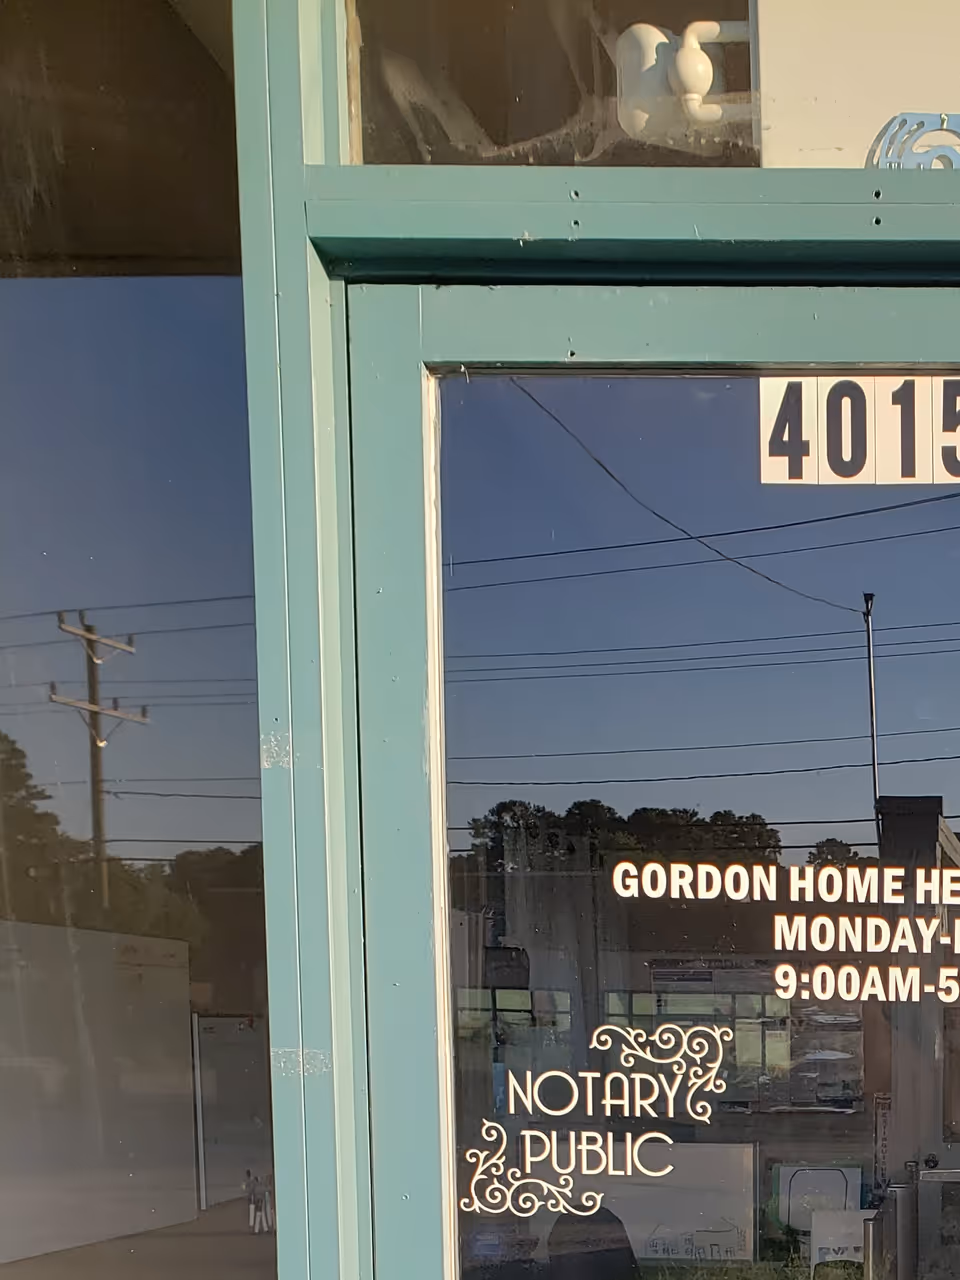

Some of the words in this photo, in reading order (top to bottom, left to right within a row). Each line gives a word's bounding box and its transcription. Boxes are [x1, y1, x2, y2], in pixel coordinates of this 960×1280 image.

[612, 861, 778, 901] GORDON
[789, 864, 905, 905] HOME
[507, 1068, 684, 1119] NOTARY
[519, 1129, 675, 1177] PUBLIC
